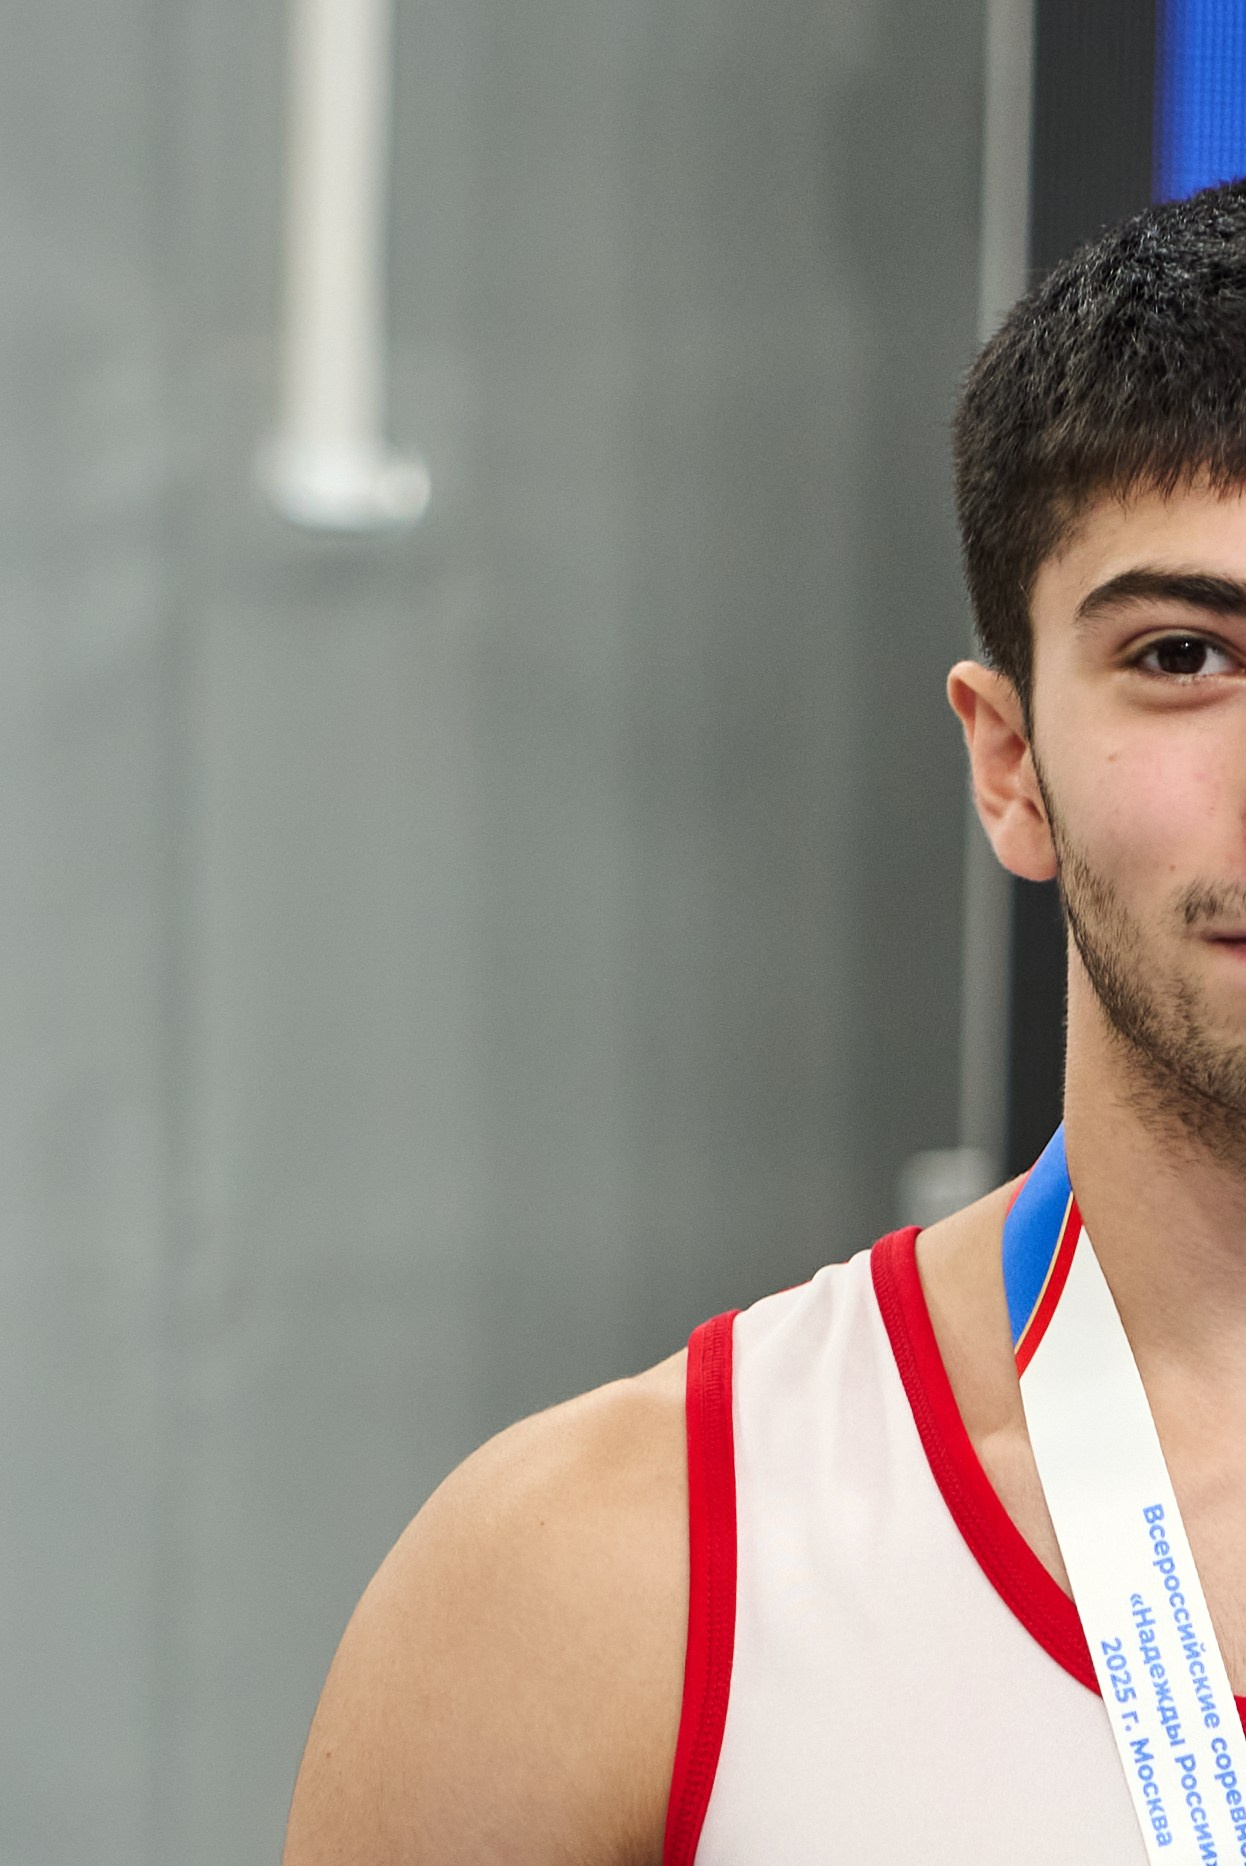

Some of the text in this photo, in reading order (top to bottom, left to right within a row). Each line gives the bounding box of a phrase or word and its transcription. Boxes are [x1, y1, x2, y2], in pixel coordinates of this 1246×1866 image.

[1130, 1593, 1186, 1748] «Надежды
[1143, 1503, 1221, 1730] Всероссийские
[1101, 1638, 1173, 1848] 2025 г. Москва
